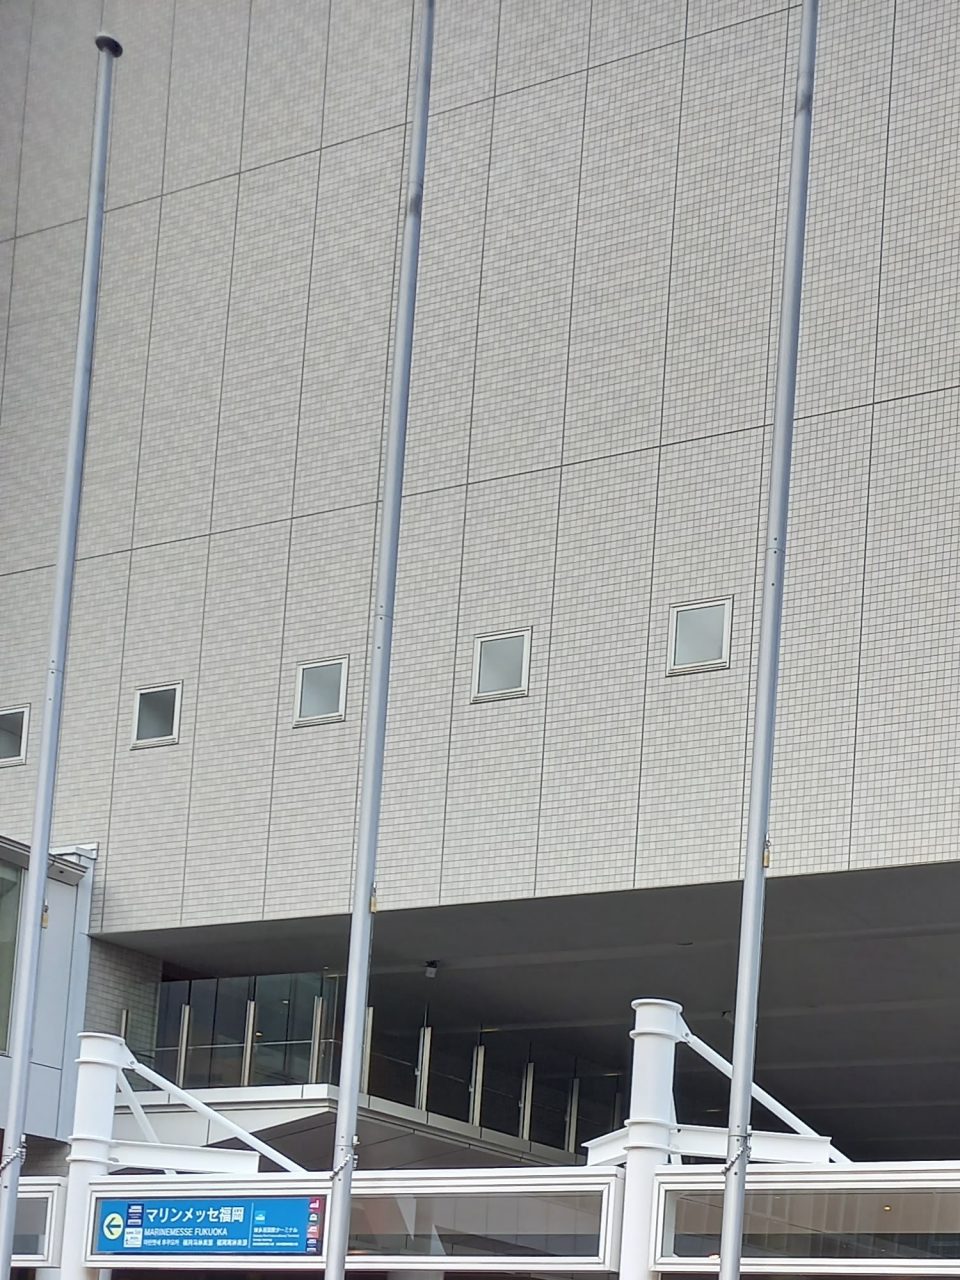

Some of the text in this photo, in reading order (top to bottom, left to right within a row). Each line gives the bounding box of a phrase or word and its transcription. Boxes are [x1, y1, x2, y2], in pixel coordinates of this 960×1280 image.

[145, 1206, 245, 1223] マリンメッセ福岡
[144, 1227, 228, 1236] MARINEMESSE FUKUOKA
